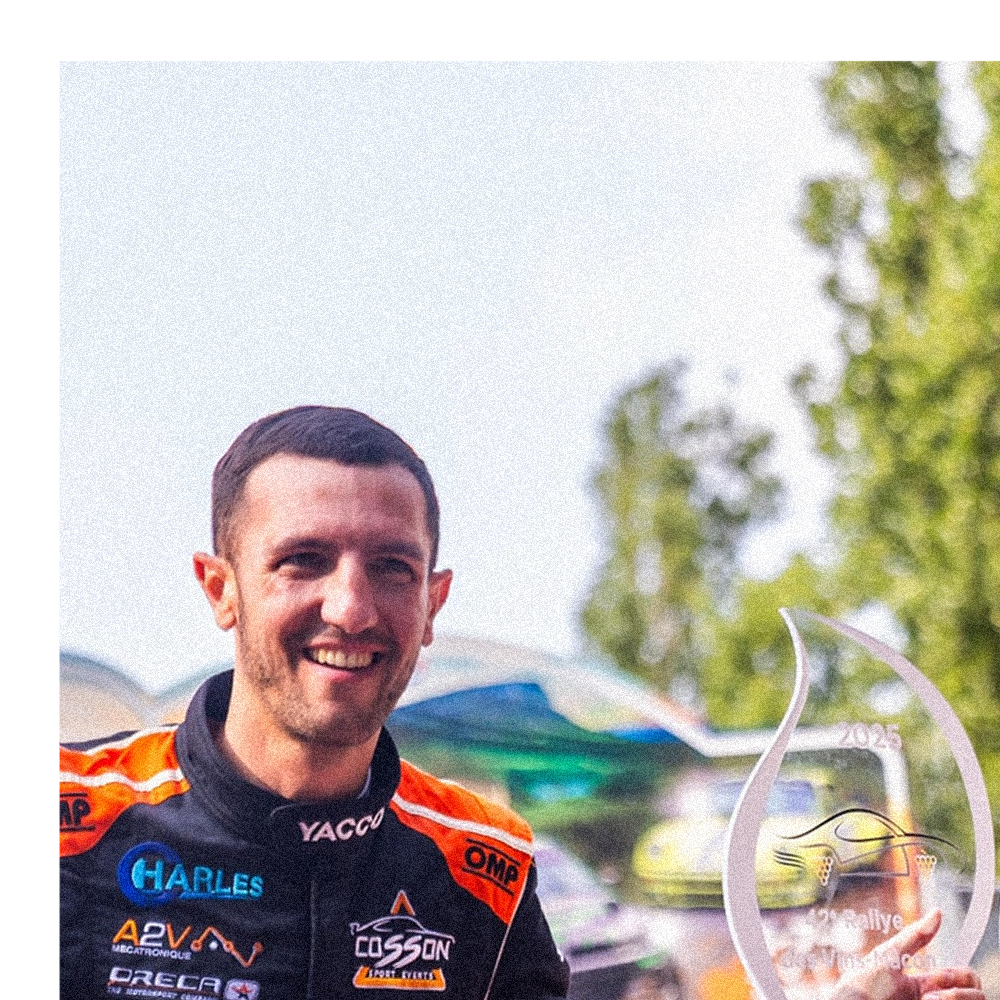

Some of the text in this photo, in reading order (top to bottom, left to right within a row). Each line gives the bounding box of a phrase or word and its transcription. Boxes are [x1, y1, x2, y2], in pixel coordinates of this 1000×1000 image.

[837, 720, 903, 750] 2025
[298, 806, 385, 842] YACCO
[117, 841, 265, 908] CHARLES
[463, 846, 519, 886] OMP
[843, 907, 904, 935] Rallye
[354, 933, 451, 969] COSSON
[109, 966, 222, 995] ORECA
